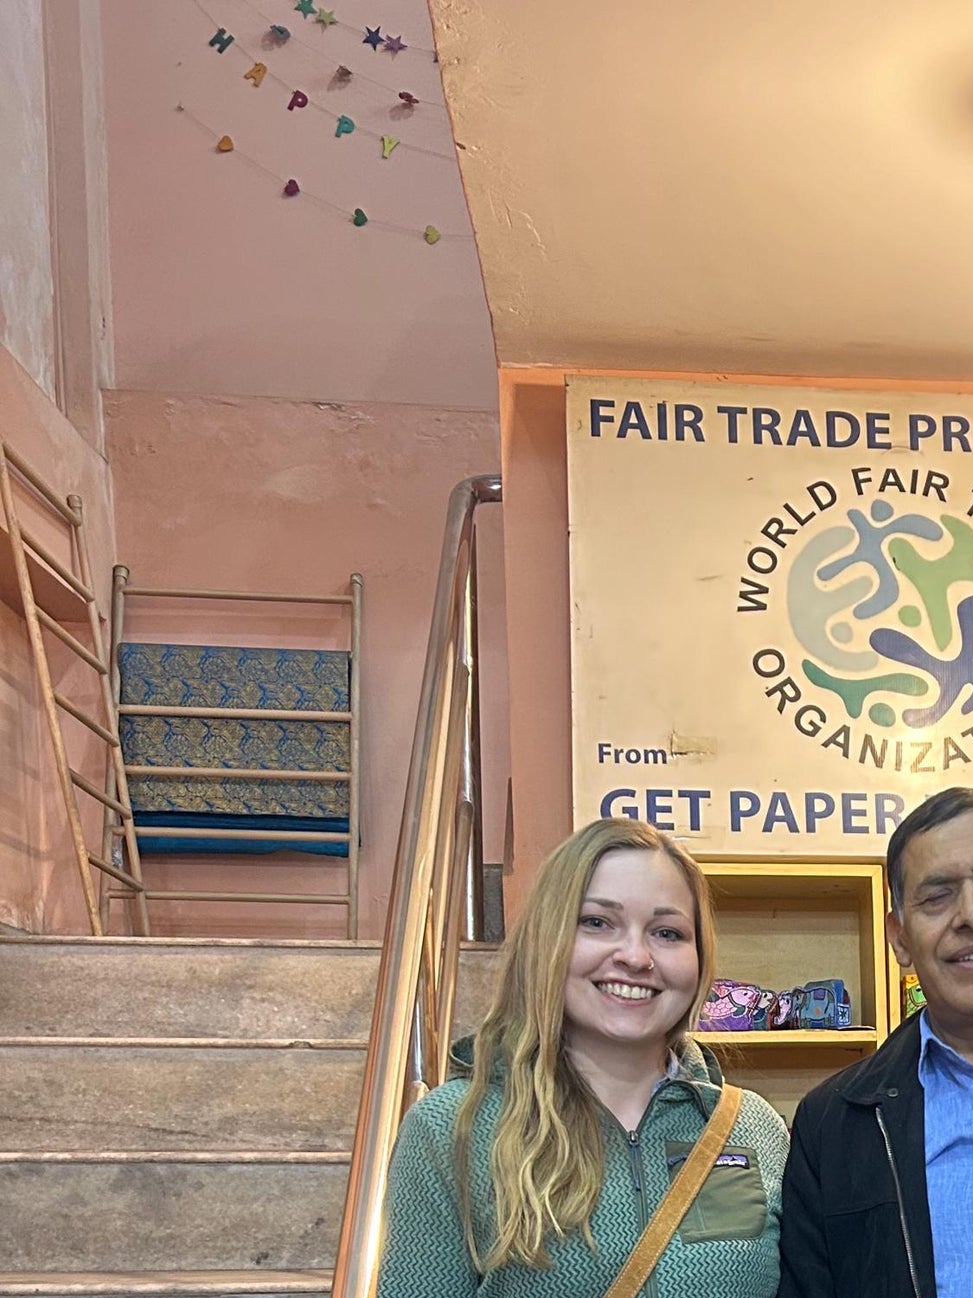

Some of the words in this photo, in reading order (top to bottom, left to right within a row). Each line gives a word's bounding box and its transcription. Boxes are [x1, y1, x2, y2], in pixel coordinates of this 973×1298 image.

[590, 399, 705, 442] FAIR
[717, 406, 892, 450] TRADE
[737, 480, 837, 613] WORLD
[851, 467, 950, 502] FAIR
[598, 743, 667, 764] From
[600, 788, 711, 831] GET
[729, 790, 905, 834] PAPER
